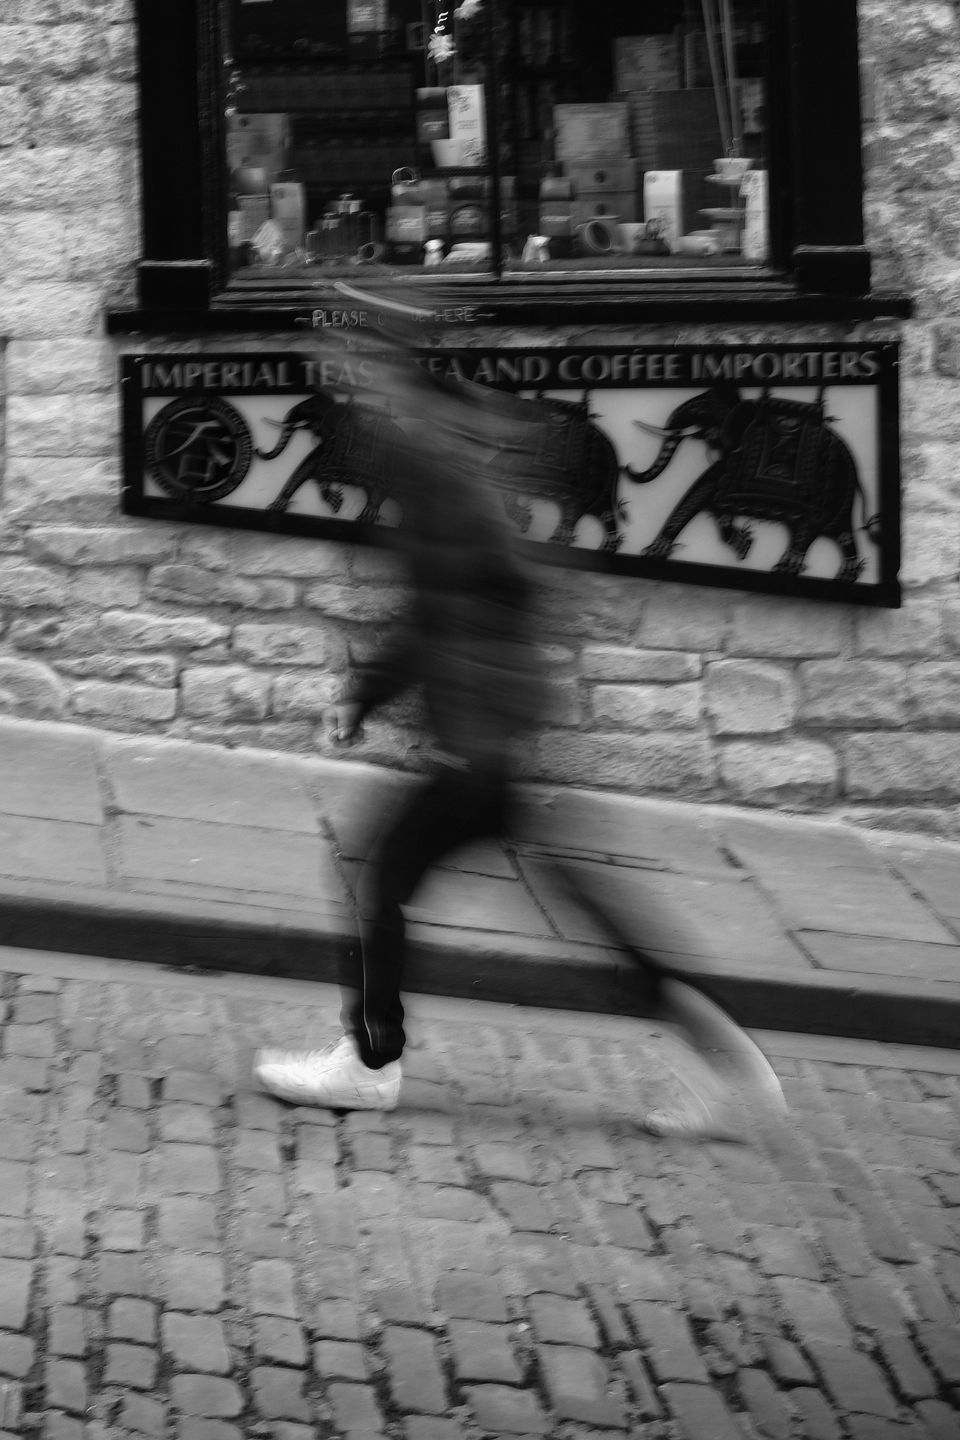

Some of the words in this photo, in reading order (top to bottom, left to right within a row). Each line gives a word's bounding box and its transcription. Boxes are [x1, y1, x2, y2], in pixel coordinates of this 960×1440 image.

[312, 308, 369, 328] PLEASE
[141, 360, 293, 389] IMPERIAL
[300, 357, 374, 388] TEAS
[473, 353, 551, 384] AND
[557, 353, 682, 382] COFFEE
[691, 350, 881, 380] IMPORTERS
